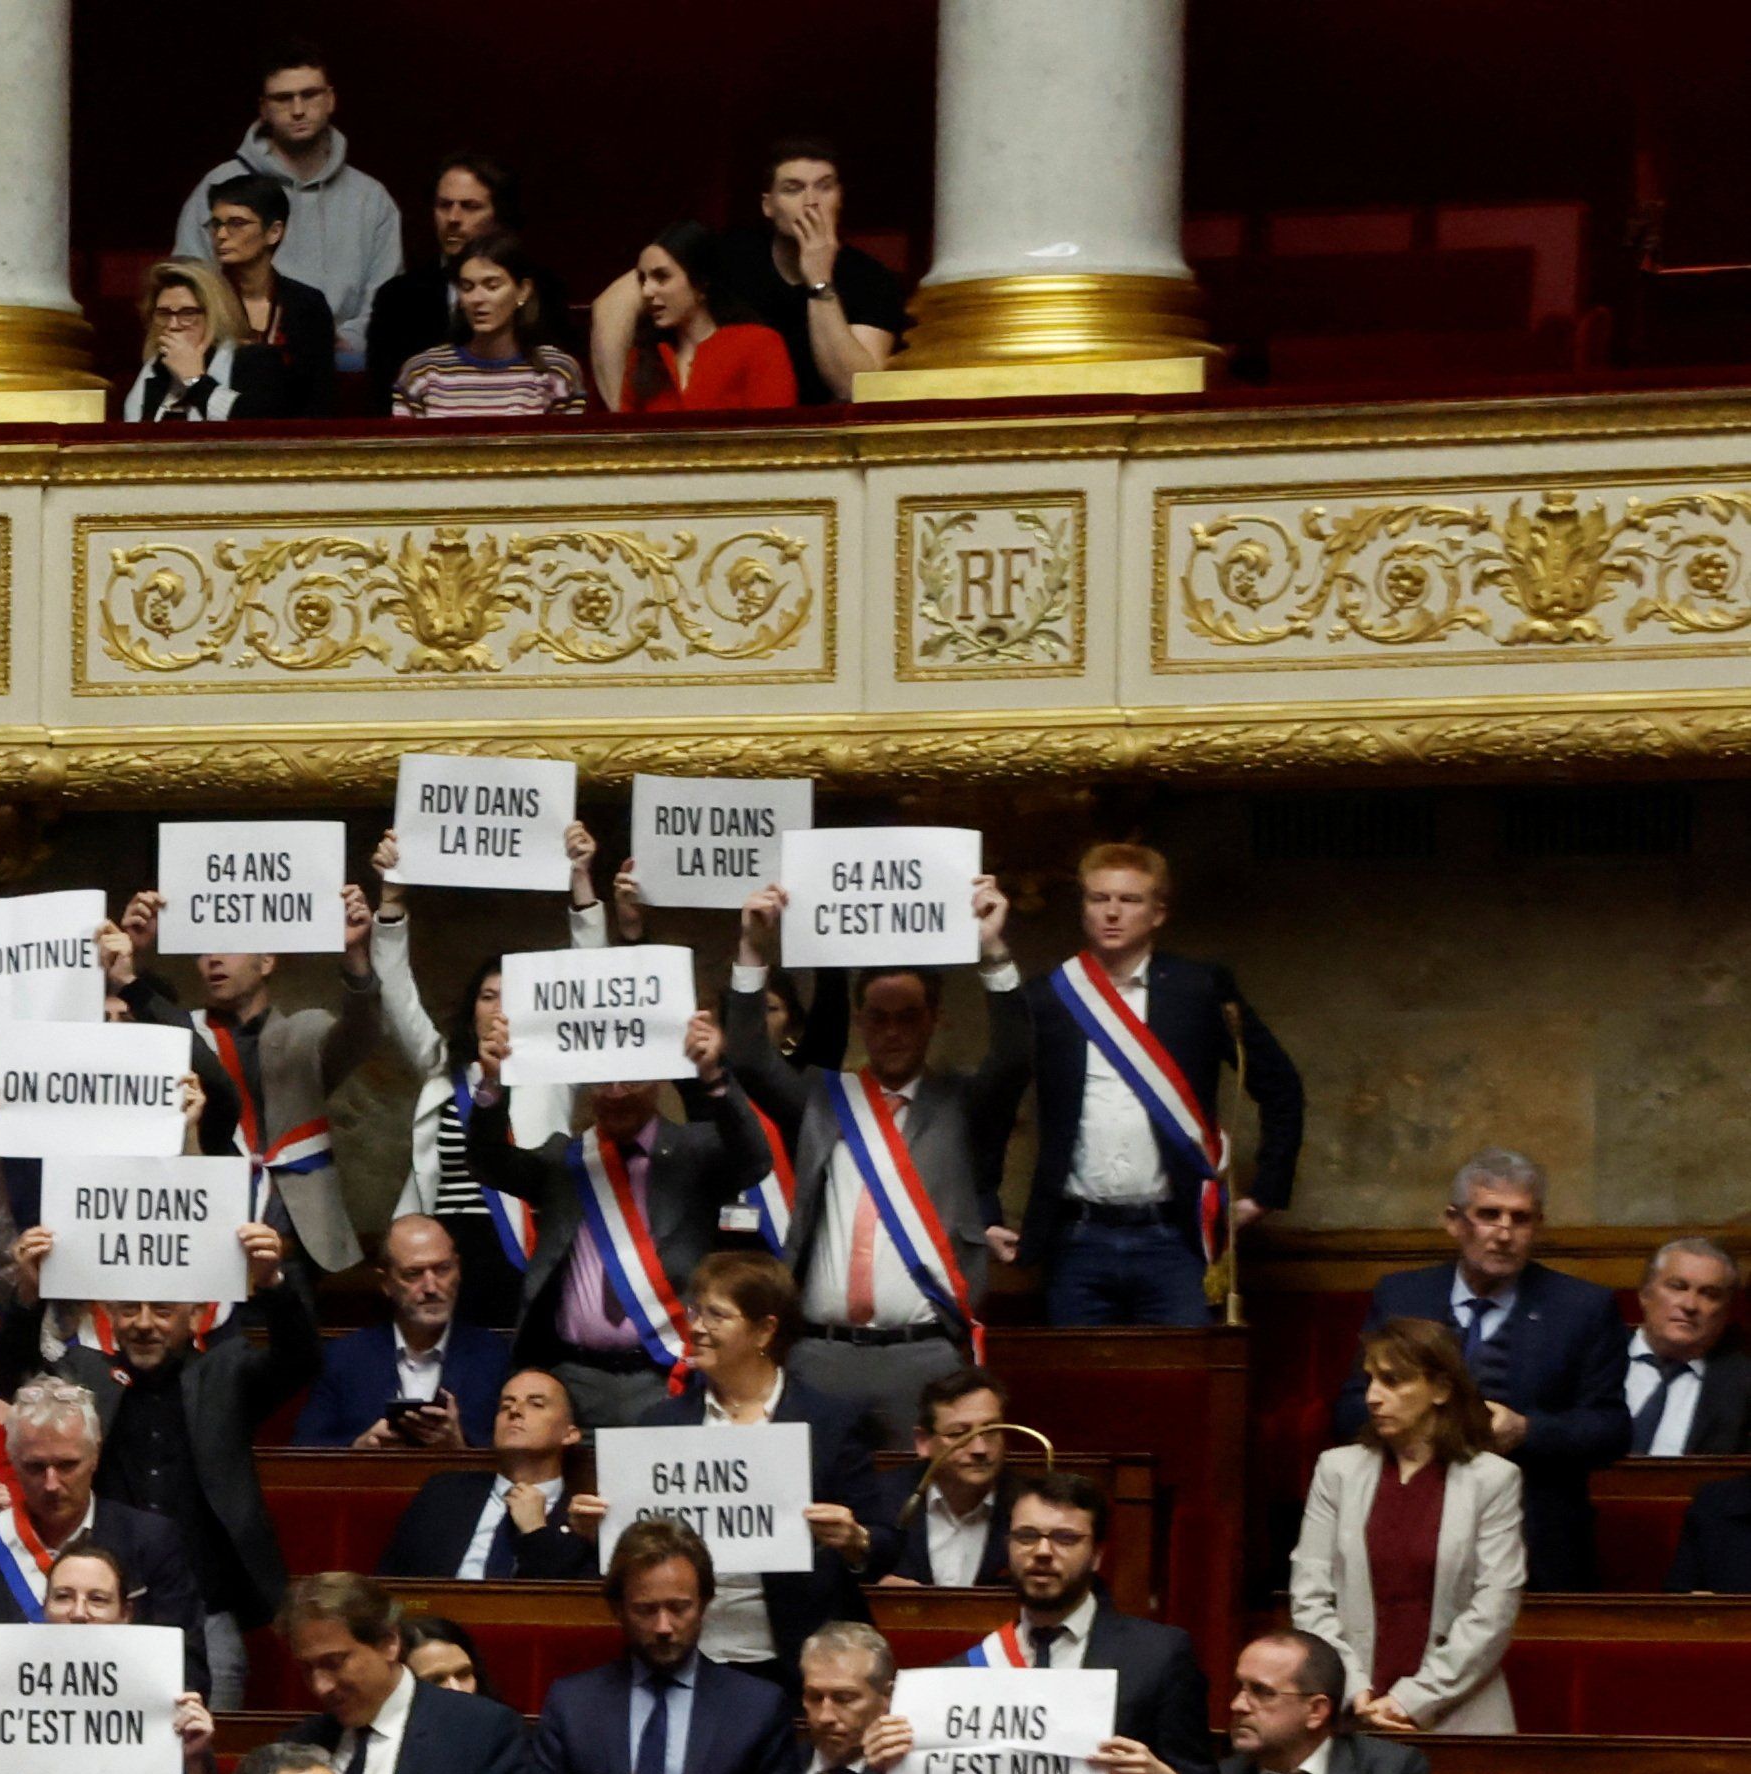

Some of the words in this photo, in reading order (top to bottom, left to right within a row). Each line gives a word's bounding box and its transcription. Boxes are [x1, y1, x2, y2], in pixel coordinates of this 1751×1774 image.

[956, 547, 1036, 621] RF
[421, 784, 468, 814] RDV
[475, 787, 539, 818] DANS
[656, 806, 702, 836] RDV
[711, 807, 774, 837] DANS
[440, 825, 467, 854] LA
[476, 827, 521, 857] RUE
[208, 854, 236, 882] 64
[244, 853, 290, 881] ANS
[677, 848, 705, 876] LA
[714, 848, 759, 877] RUE
[833, 862, 863, 891] 64
[872, 859, 921, 890] ANS
[191, 894, 255, 923] C'EST
[263, 893, 311, 922] NON
[816, 903, 883, 935] C'EST
[892, 903, 943, 933] NON
[535, 981, 584, 1010] NON
[593, 976, 659, 1008] C'EST
[557, 1020, 606, 1051] ANS
[614, 1018, 644, 1048] 64
[4, 1071, 37, 1102] ON
[47, 1072, 173, 1106] CONTINUE
[77, 1188, 128, 1220] RDV
[138, 1189, 207, 1221] DANS
[100, 1234, 129, 1265] LA
[140, 1234, 189, 1266] RUE
[653, 1463, 686, 1494] 64
[695, 1460, 747, 1493] ANS
[717, 1505, 772, 1537] NON
[19, 1662, 53, 1696] 64
[62, 1662, 117, 1696] ANS
[0, 1709, 76, 1744] C'EST
[85, 1710, 143, 1744] NON
[947, 1706, 980, 1739] 64
[989, 1706, 1046, 1740] ANS
